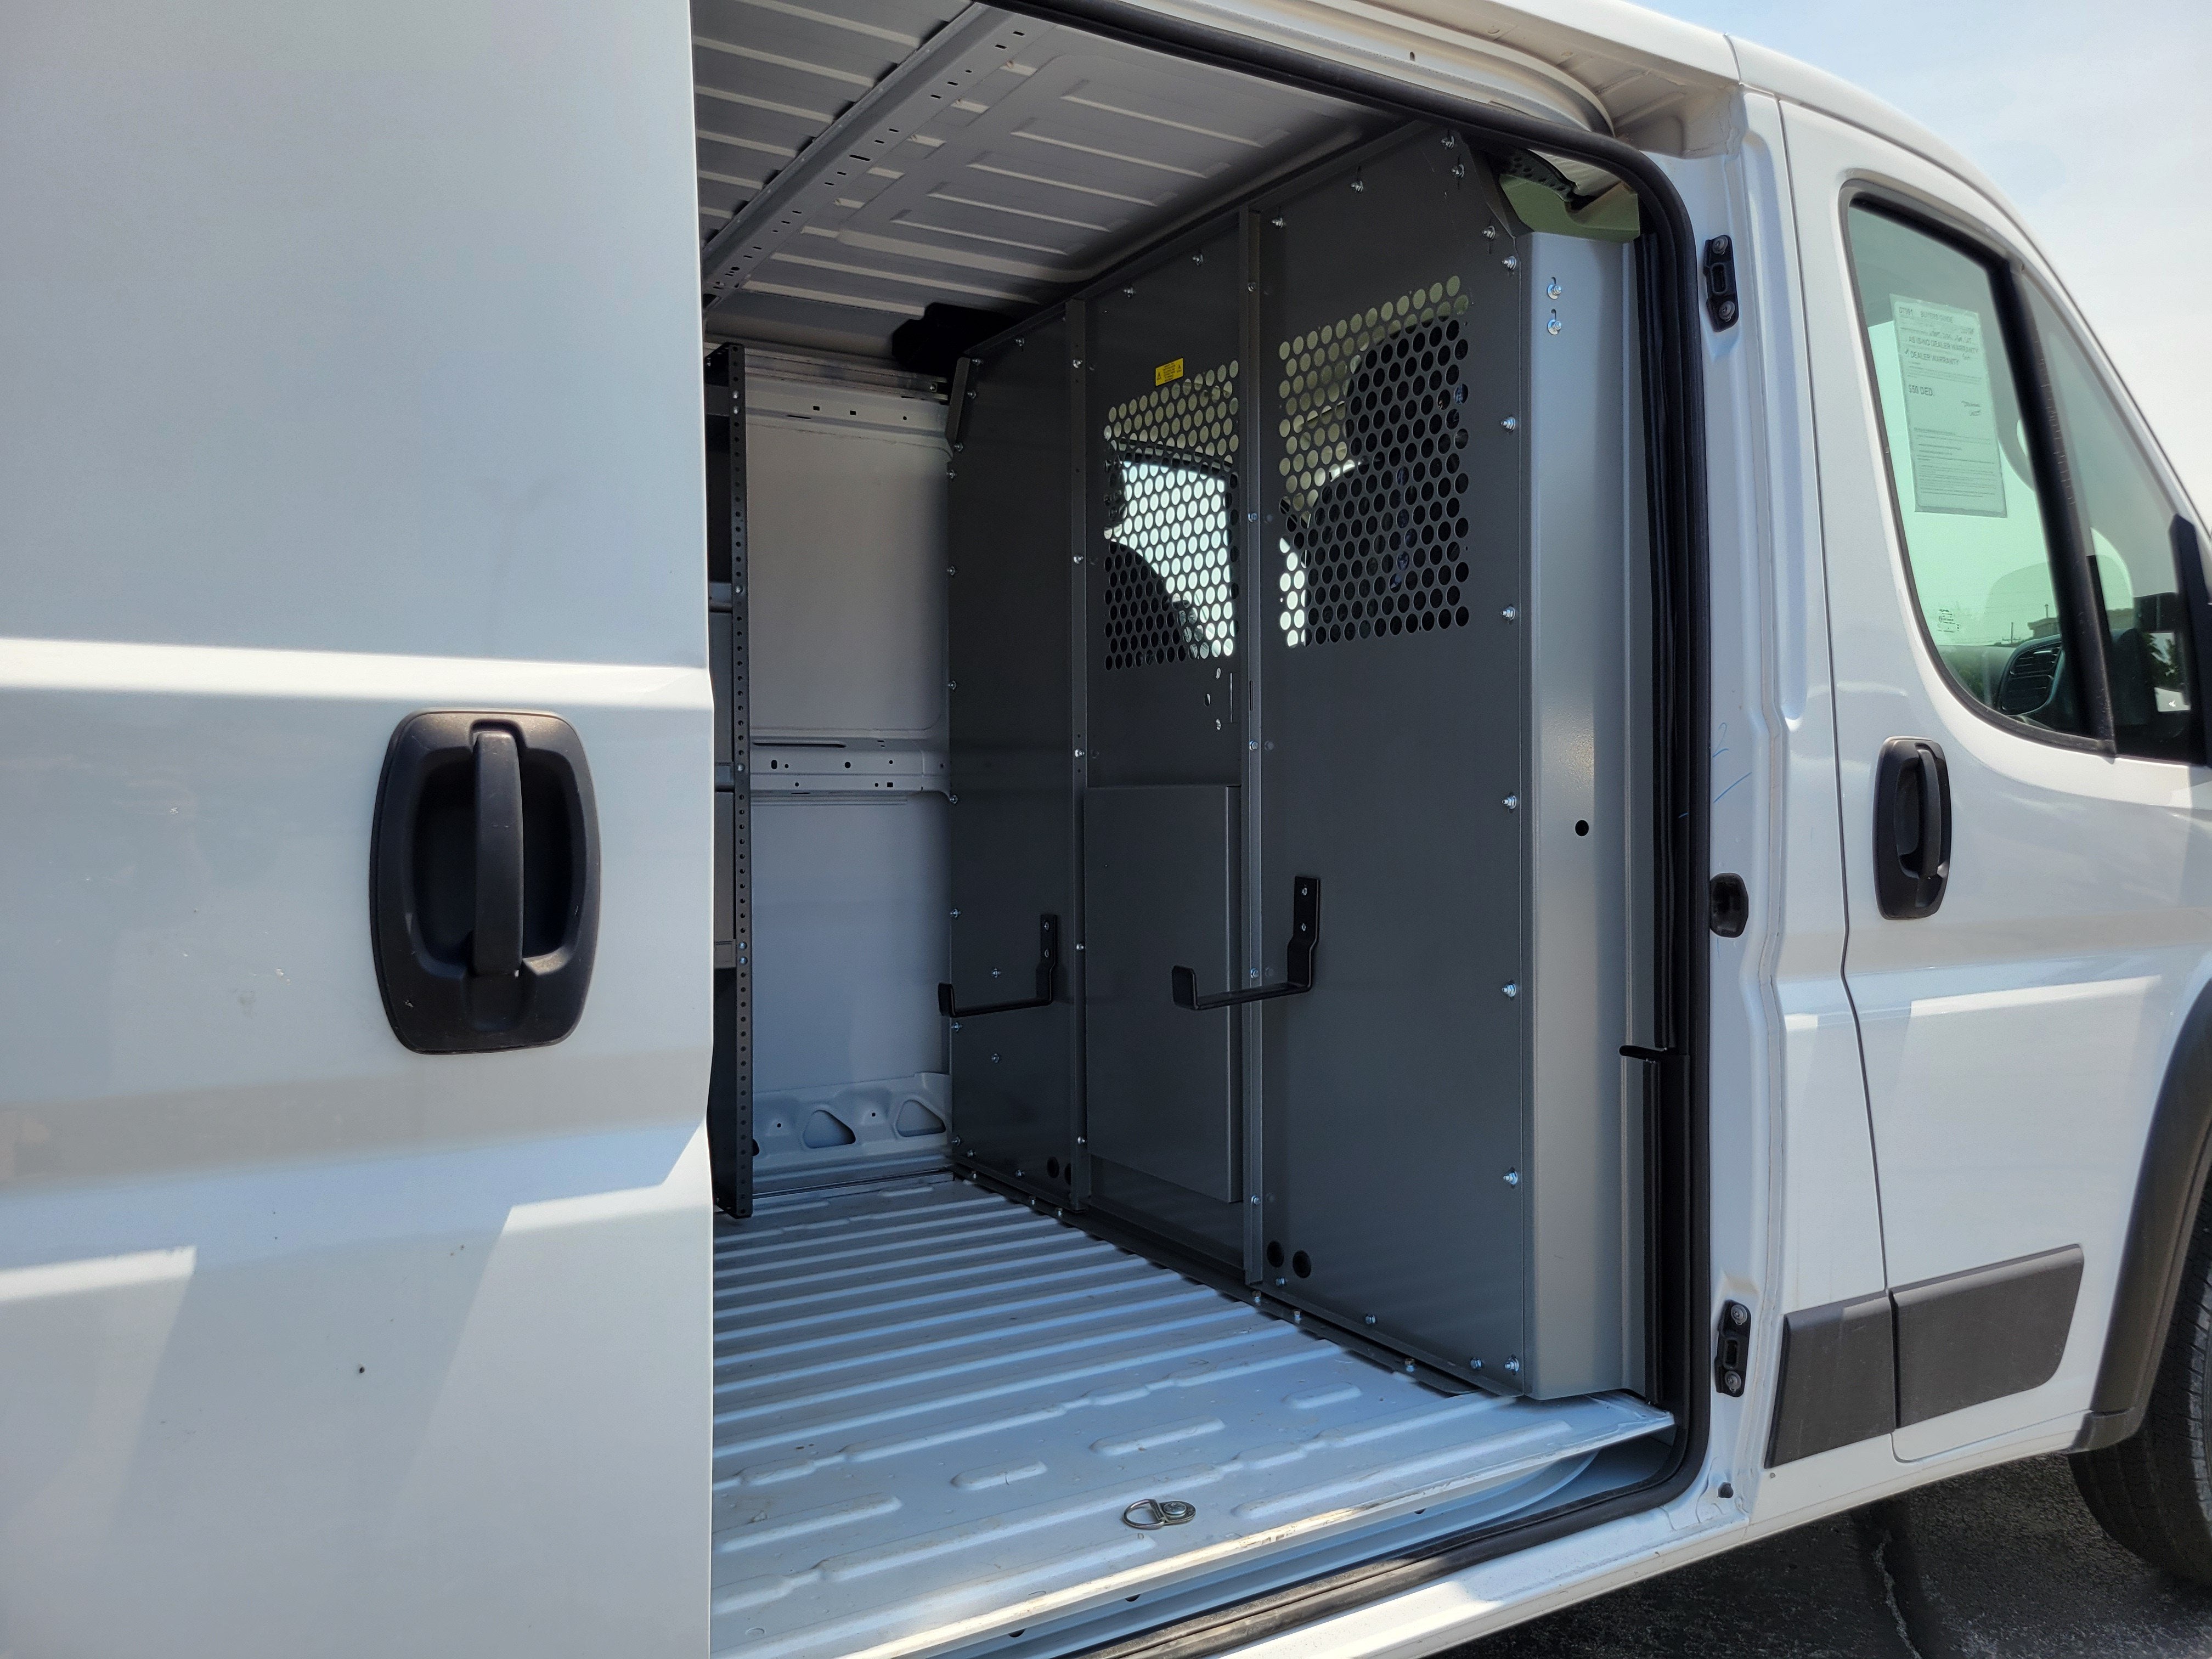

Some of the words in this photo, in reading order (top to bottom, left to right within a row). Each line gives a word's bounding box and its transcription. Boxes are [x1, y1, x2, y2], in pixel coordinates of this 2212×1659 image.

[1931, 340, 1950, 349] DEALER
[1951, 344, 1978, 354] WARRANTY
[1910, 351, 1930, 360] DEALER
[1932, 356, 1959, 365] WARRANTY
